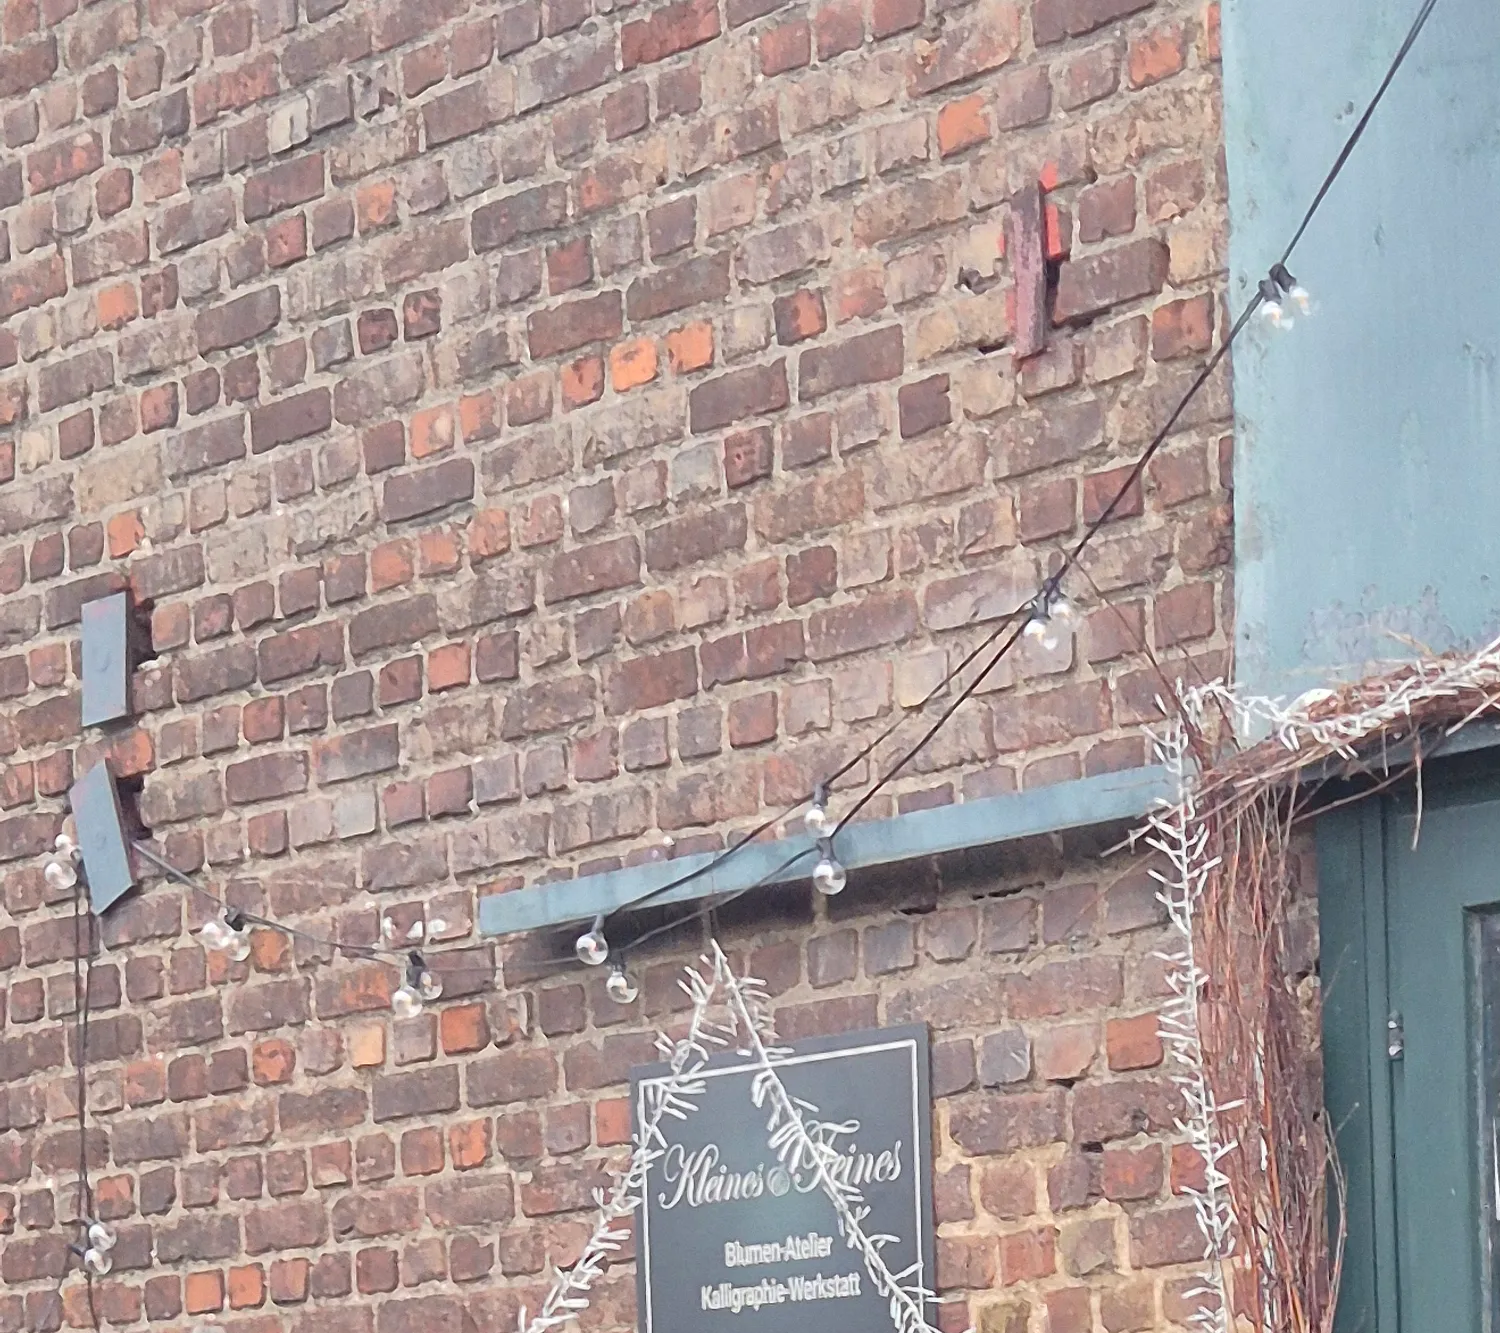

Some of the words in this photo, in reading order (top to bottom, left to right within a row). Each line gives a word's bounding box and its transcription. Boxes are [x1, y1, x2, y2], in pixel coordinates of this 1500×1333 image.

[658, 1144, 764, 1209] Kleines
[794, 1119, 902, 1193] Feines
[724, 1233, 833, 1267] Blumen-Atelier
[700, 1272, 861, 1314] Kalligraphie-Werkstatt
